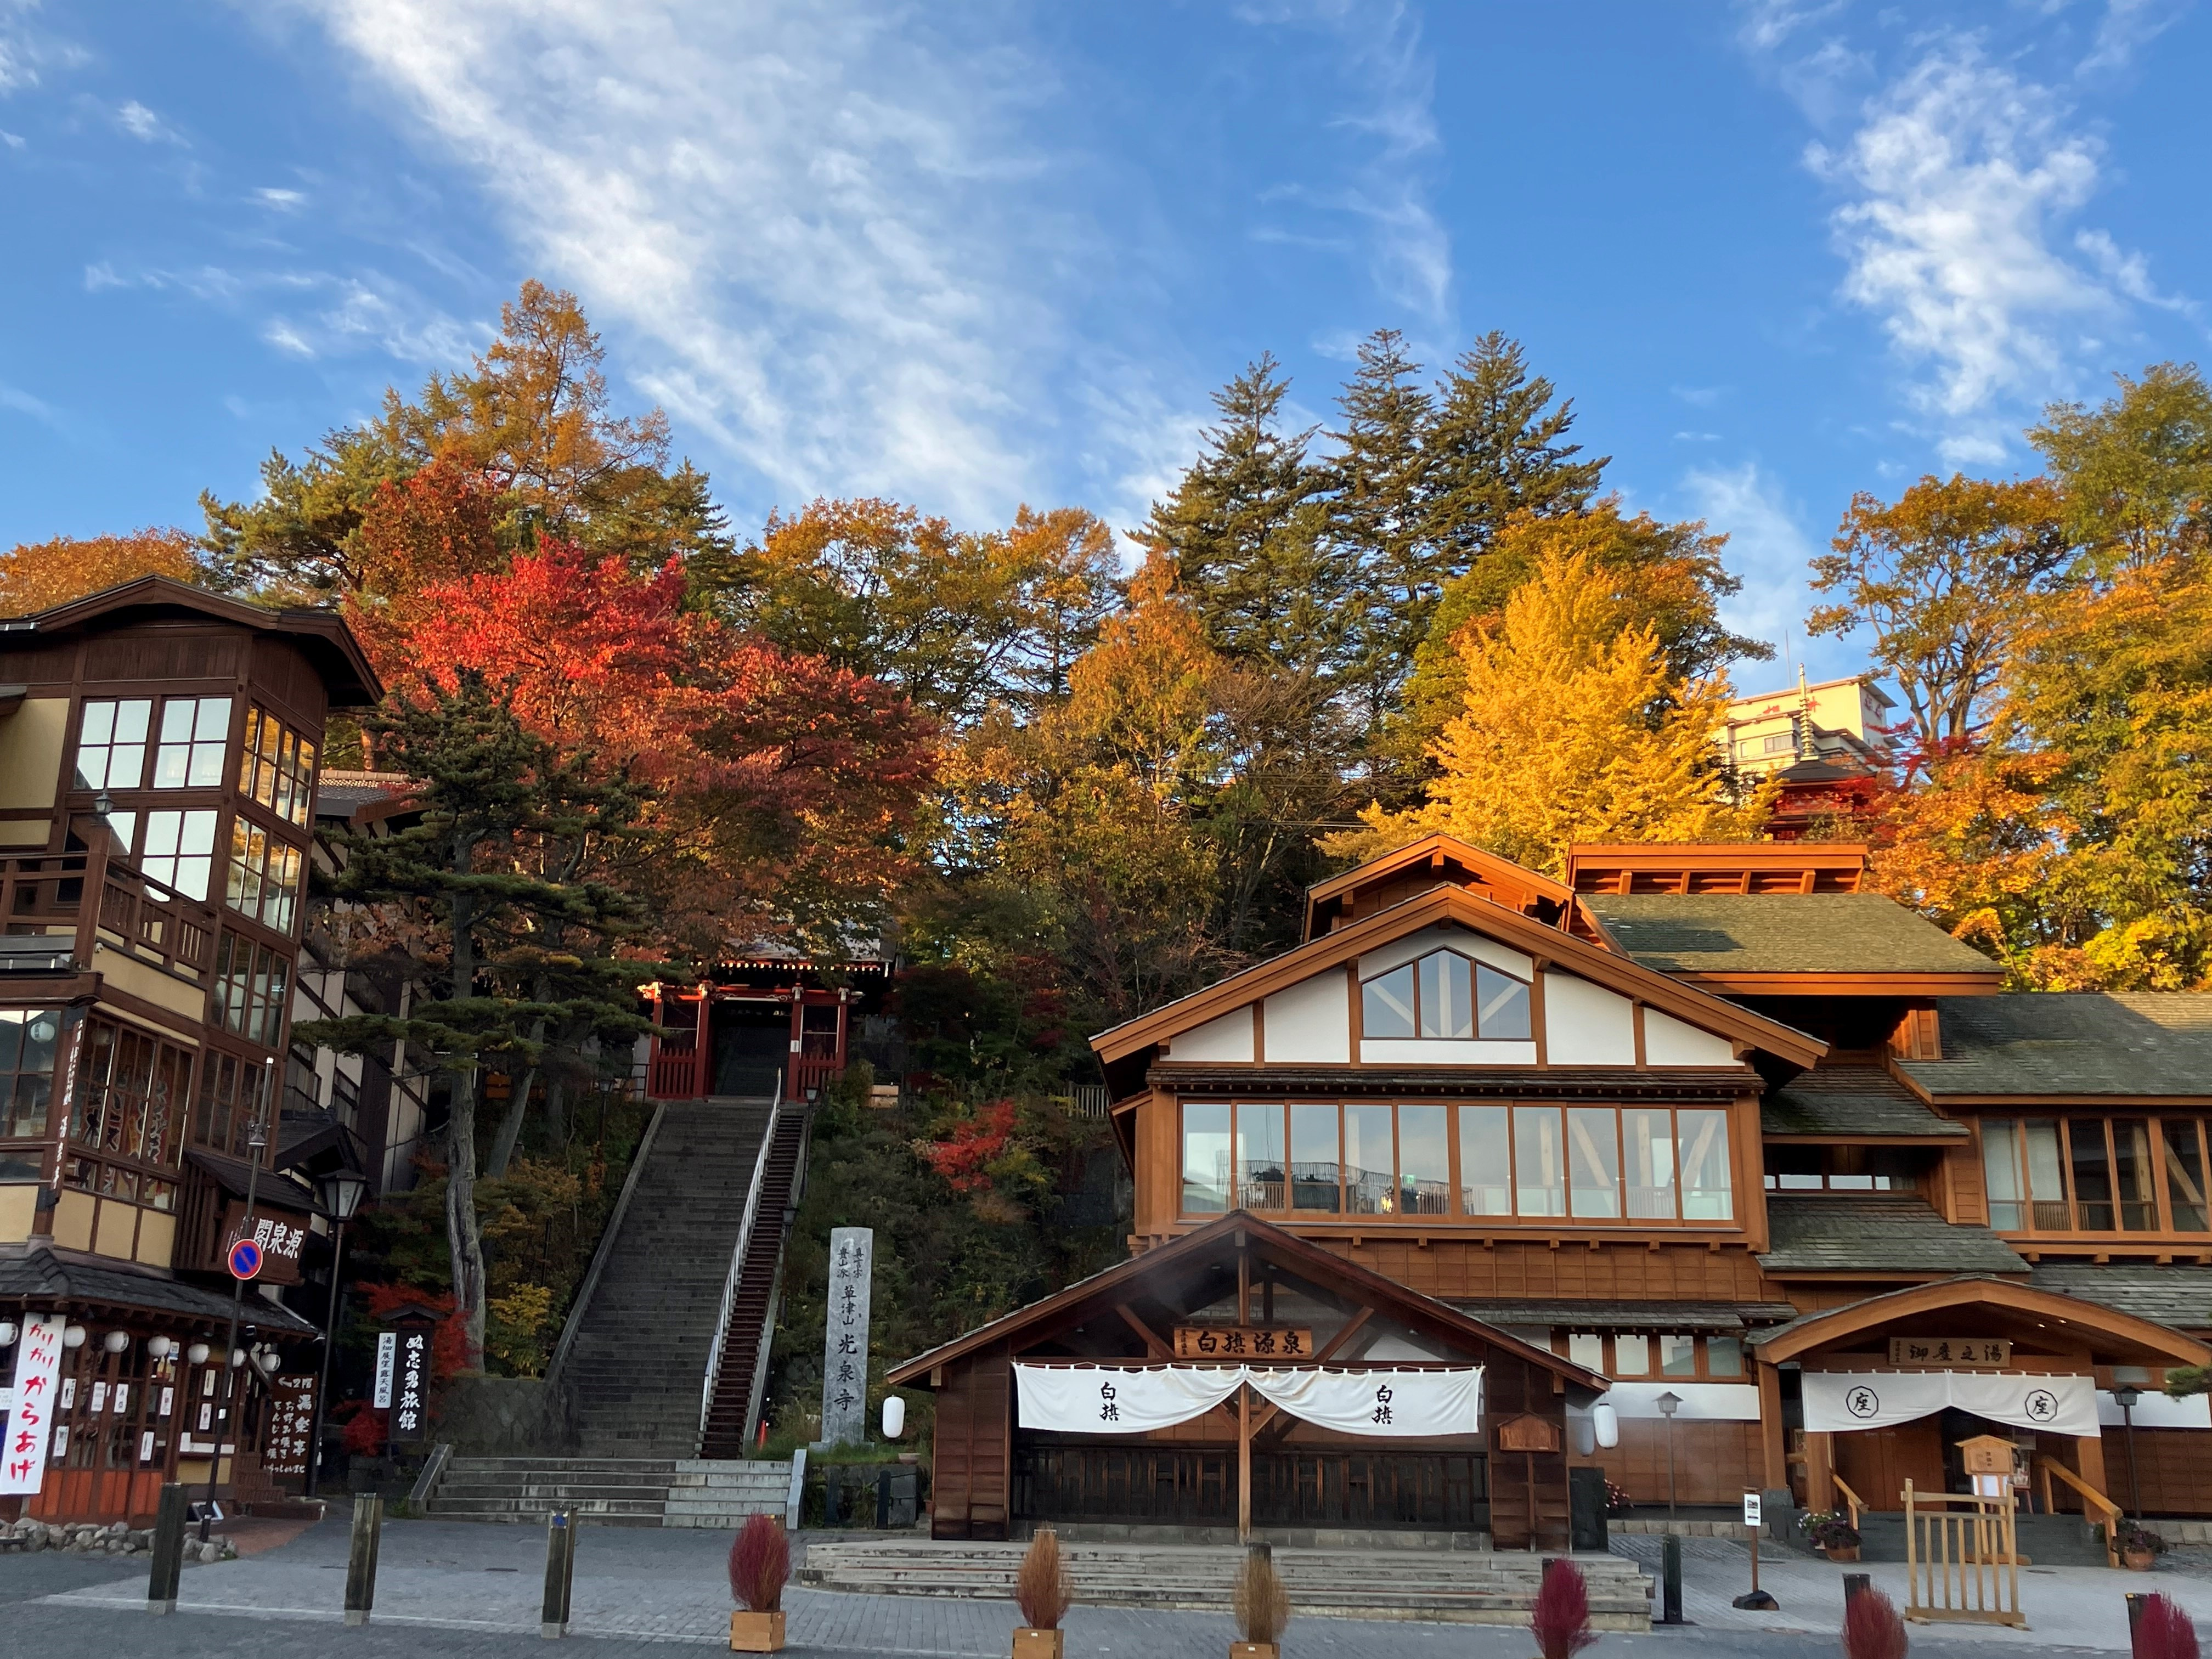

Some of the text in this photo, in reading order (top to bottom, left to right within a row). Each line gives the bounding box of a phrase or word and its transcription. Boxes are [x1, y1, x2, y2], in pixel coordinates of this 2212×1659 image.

[1197, 1330, 1304, 1355] 白旗源泉
[1099, 1381, 1120, 1420] 白旗
[1372, 1385, 1393, 1424] 白旗
